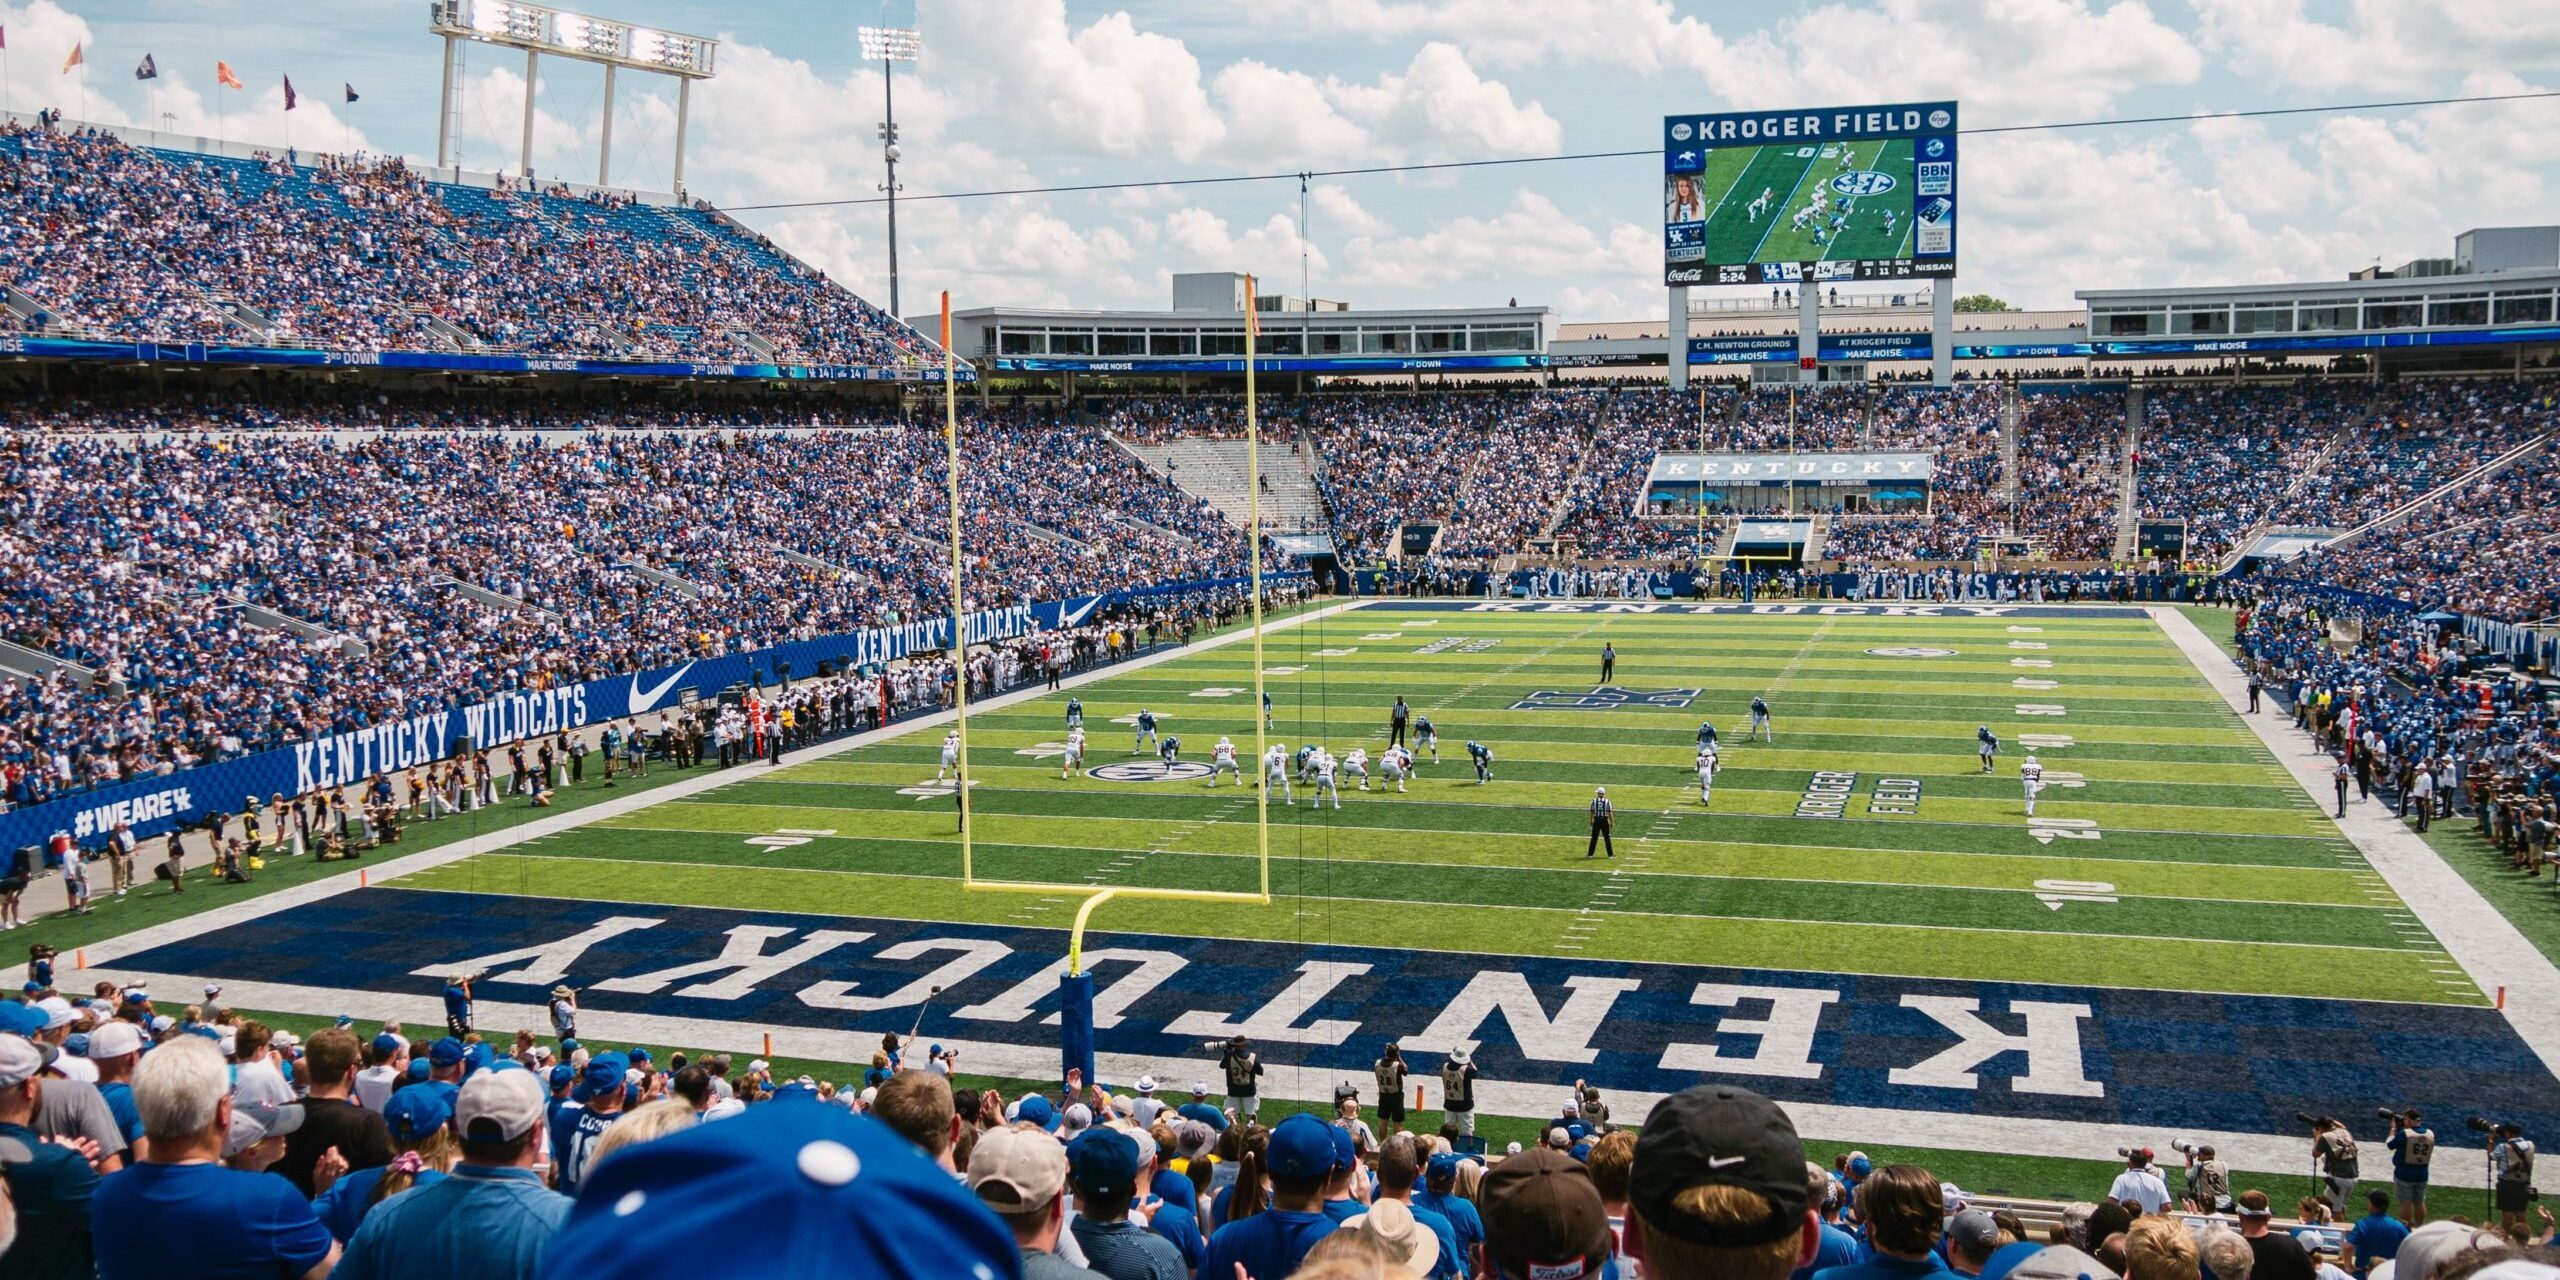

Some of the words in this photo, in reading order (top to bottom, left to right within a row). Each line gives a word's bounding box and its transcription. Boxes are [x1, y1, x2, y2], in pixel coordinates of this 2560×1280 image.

[1699, 116, 1820, 140] KROGER
[1835, 111, 1920, 134] FIELD
[1921, 165, 1950, 176] BBN
[1785, 267, 1798, 275] 14
[1818, 266, 1830, 274] 14
[1880, 267, 1889, 275] 11
[1915, 263, 1953, 271] NISSAN
[1668, 269, 1702, 281] Coca-Cola
[1720, 273, 1746, 282] 5:24
[0, 338, 24, 352] ISE
[1714, 341, 1749, 349] NEWTON
[1751, 340, 1791, 348] GROUNDS
[1851, 338, 1885, 346] KROGER
[1887, 337, 1911, 345] FIELD
[2194, 343, 2218, 351] MAKE
[2219, 341, 2248, 350] NOISE
[1714, 353, 1739, 361] MAKE
[1740, 351, 1768, 360] NOISE
[1845, 350, 1871, 359] MAKE
[1872, 348, 1902, 357] NOISE
[2030, 347, 2058, 355] DOWN
[343, 352, 379, 364] DOWN
[527, 360, 550, 370] MAKE
[552, 361, 577, 370] NOISE
[707, 365, 734, 375] DOWN
[1110, 362, 1133, 370] NOISE
[819, 369, 829, 378] 14
[850, 369, 861, 378] 14
[878, 371, 895, 379] 5:24
[925, 371, 939, 380] 3RD
[965, 372, 975, 380] 24
[1668, 461, 1916, 475] KENTUCKY
[1464, 603, 2019, 617] KENTUCKY
[857, 618, 947, 665] KENTUCKY
[295, 711, 448, 795] KENTUCKY
[464, 683, 586, 750] WILDCATS
[1274, 756, 1280, 766] 6
[2025, 767, 2037, 776] 88
[1794, 771, 1858, 818] KROGER
[1868, 778, 1922, 815] FIELD
[2027, 817, 2101, 840] 20
[408, 916, 2104, 1097] KENTUCKY
[2413, 1143, 2428, 1156] 62
